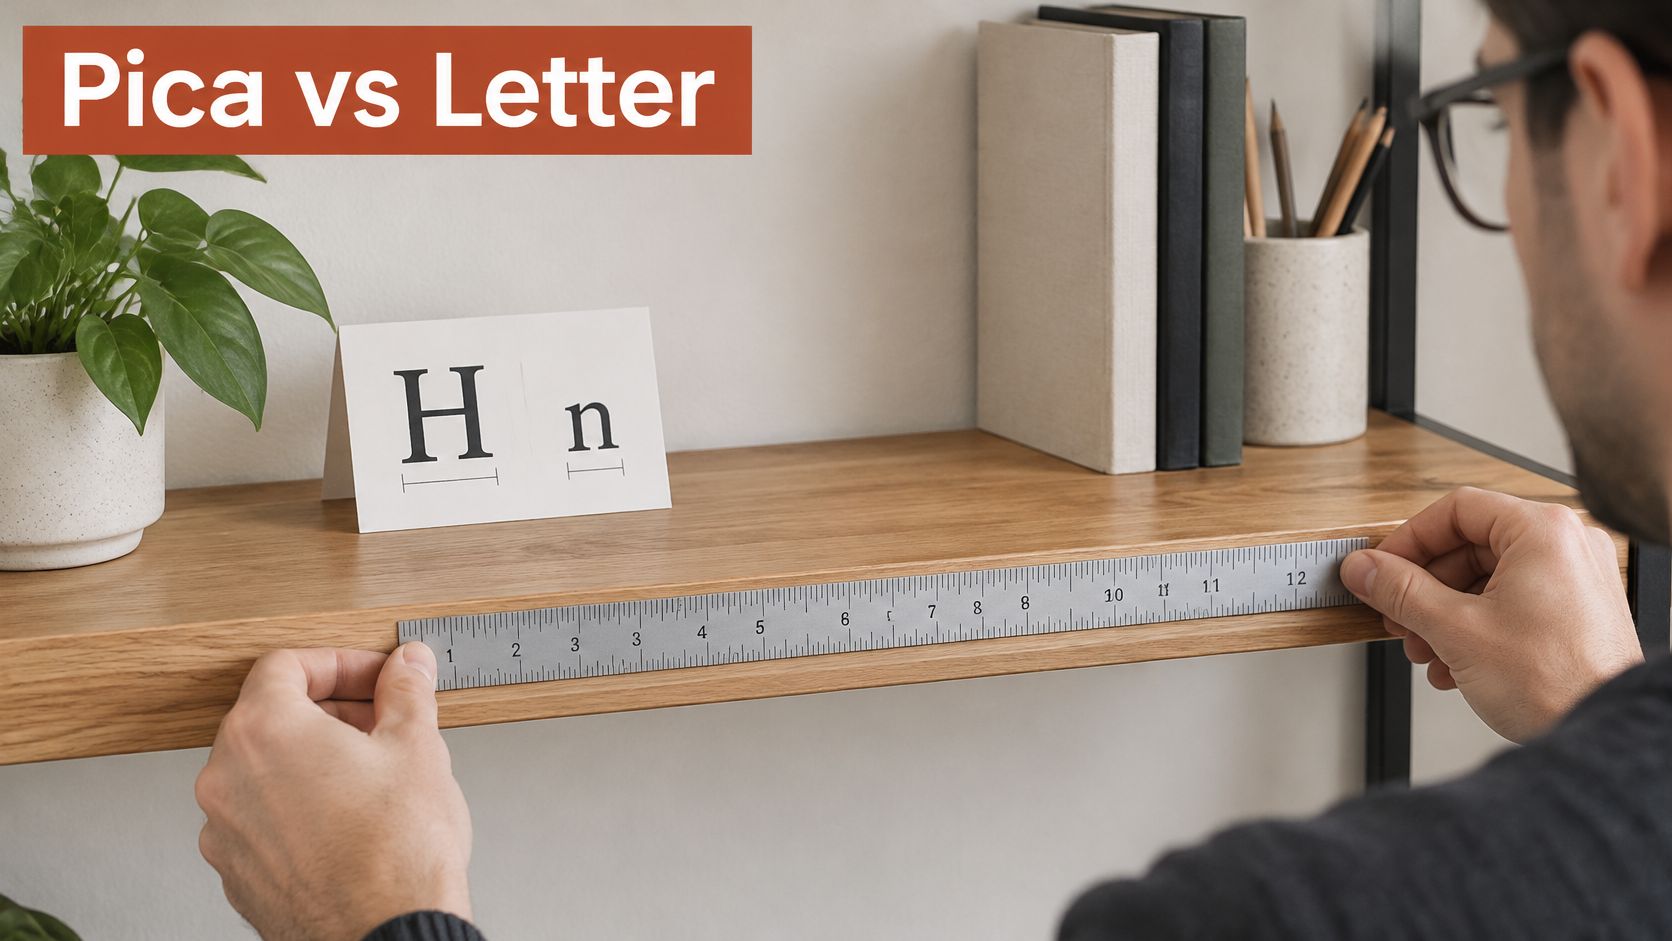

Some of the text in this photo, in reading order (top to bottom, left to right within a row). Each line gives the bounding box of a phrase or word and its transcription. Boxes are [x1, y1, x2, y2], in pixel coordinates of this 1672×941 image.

[393, 364, 620, 464] H n
[446, 648, 454, 663] 1
[511, 642, 522, 658] 2
[570, 636, 580, 653] 3
[631, 631, 642, 647] 3
[696, 624, 708, 640] 4
[755, 619, 765, 635] 5
[840, 611, 850, 627] 6
[927, 604, 937, 620] 7
[973, 600, 983, 616] 8
[1020, 595, 1030, 611] 8
[1104, 587, 1124, 603] 10
[1202, 578, 1220, 593] 11
[1286, 570, 1307, 586] 12
